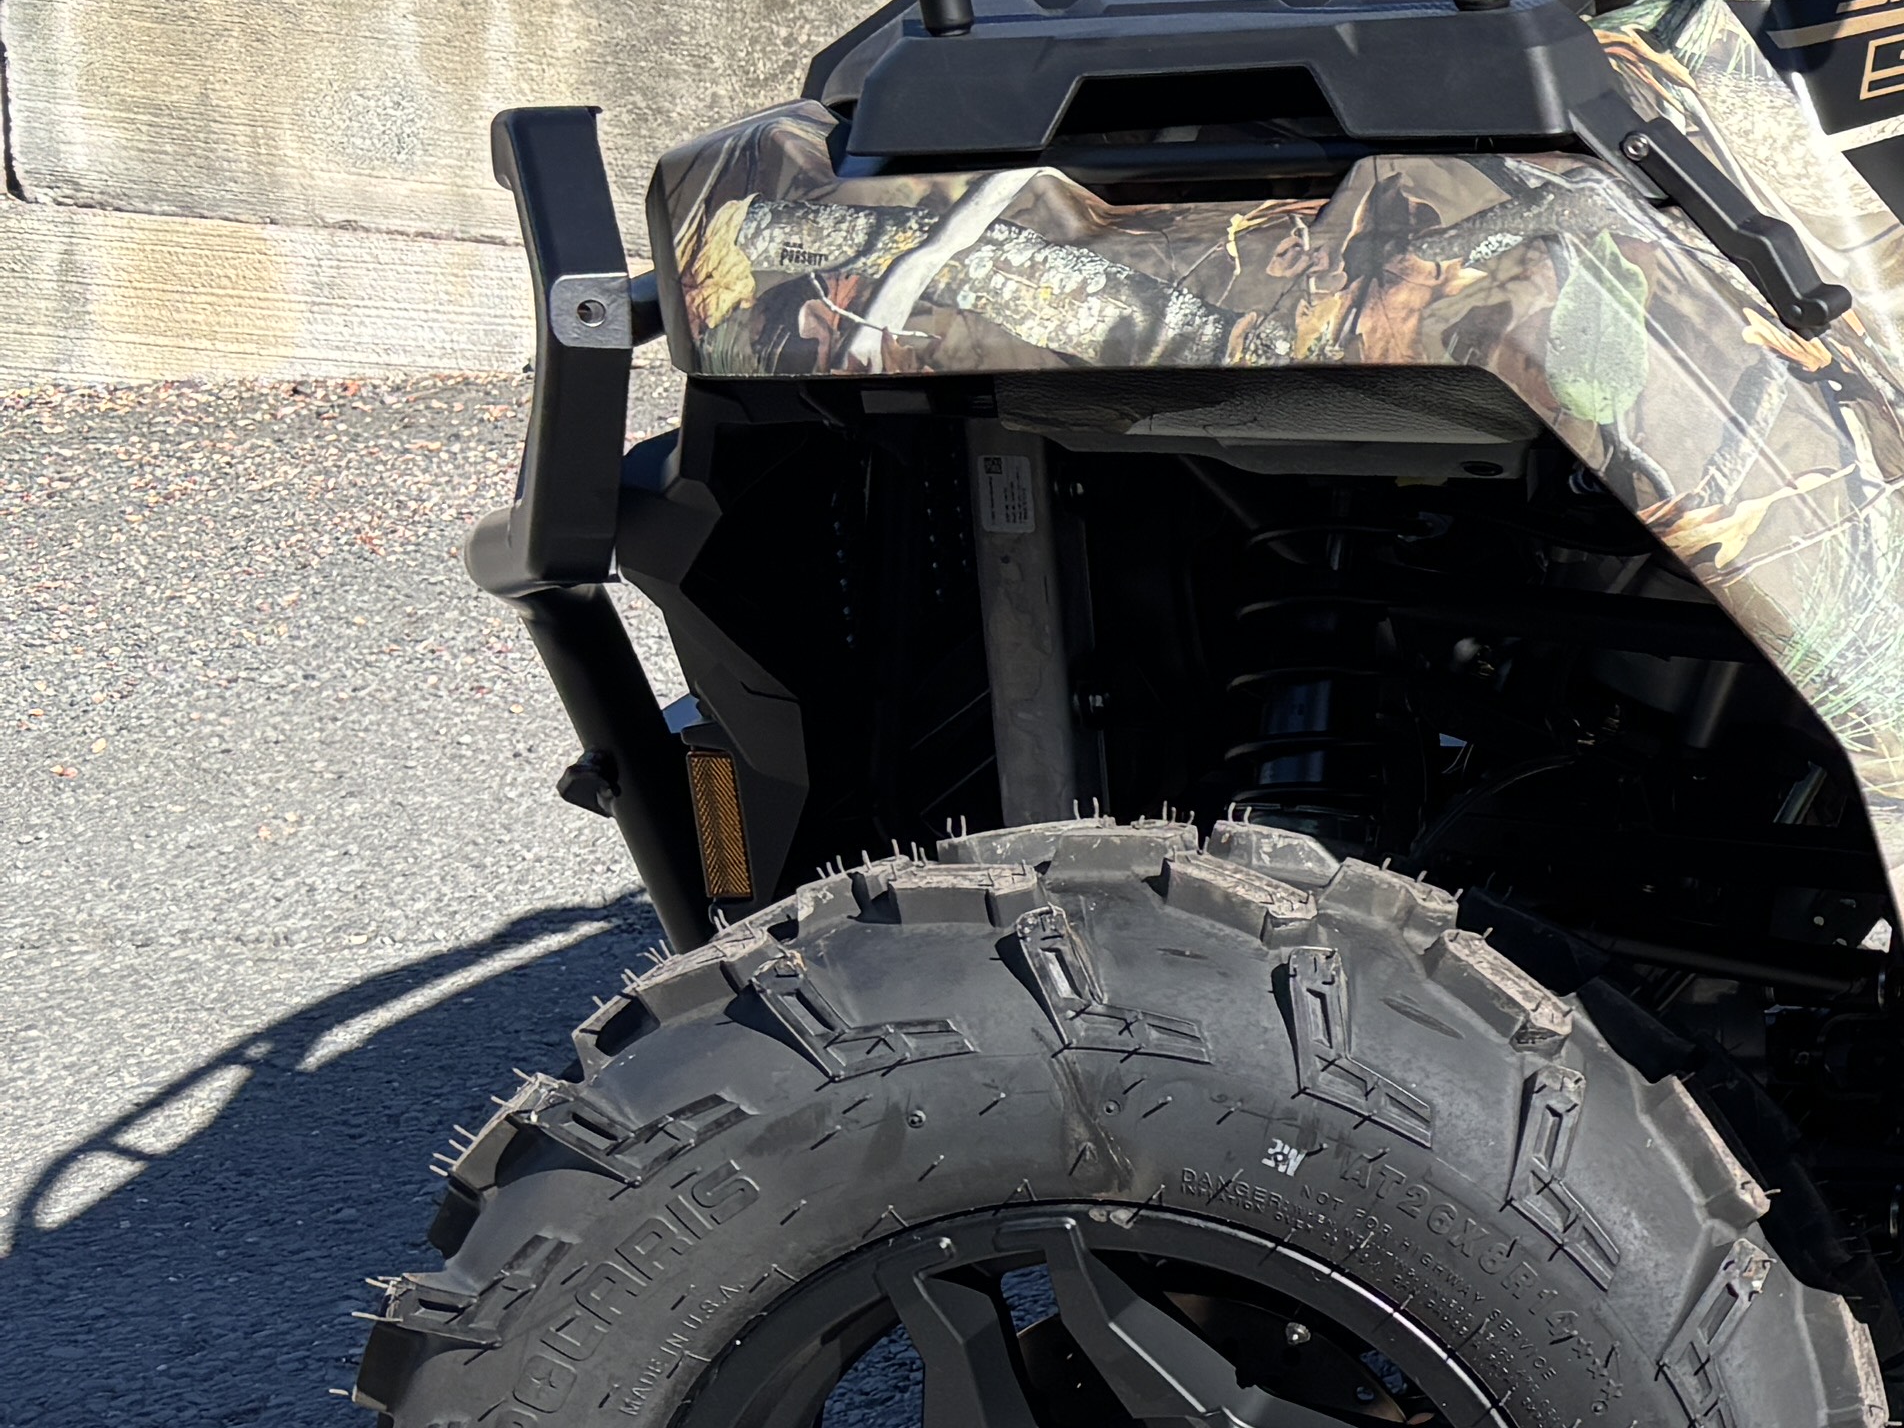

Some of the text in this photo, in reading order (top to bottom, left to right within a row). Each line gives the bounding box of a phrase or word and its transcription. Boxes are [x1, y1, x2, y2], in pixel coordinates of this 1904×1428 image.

[1297, 1184, 1345, 1214] NOT
[1349, 1207, 1393, 1240] FOR
[1393, 1233, 1488, 1308] HIGHWAY
[1483, 1305, 1560, 1384] SERVICE
[617, 1355, 671, 1419] MADE
[660, 1329, 691, 1357] IN
